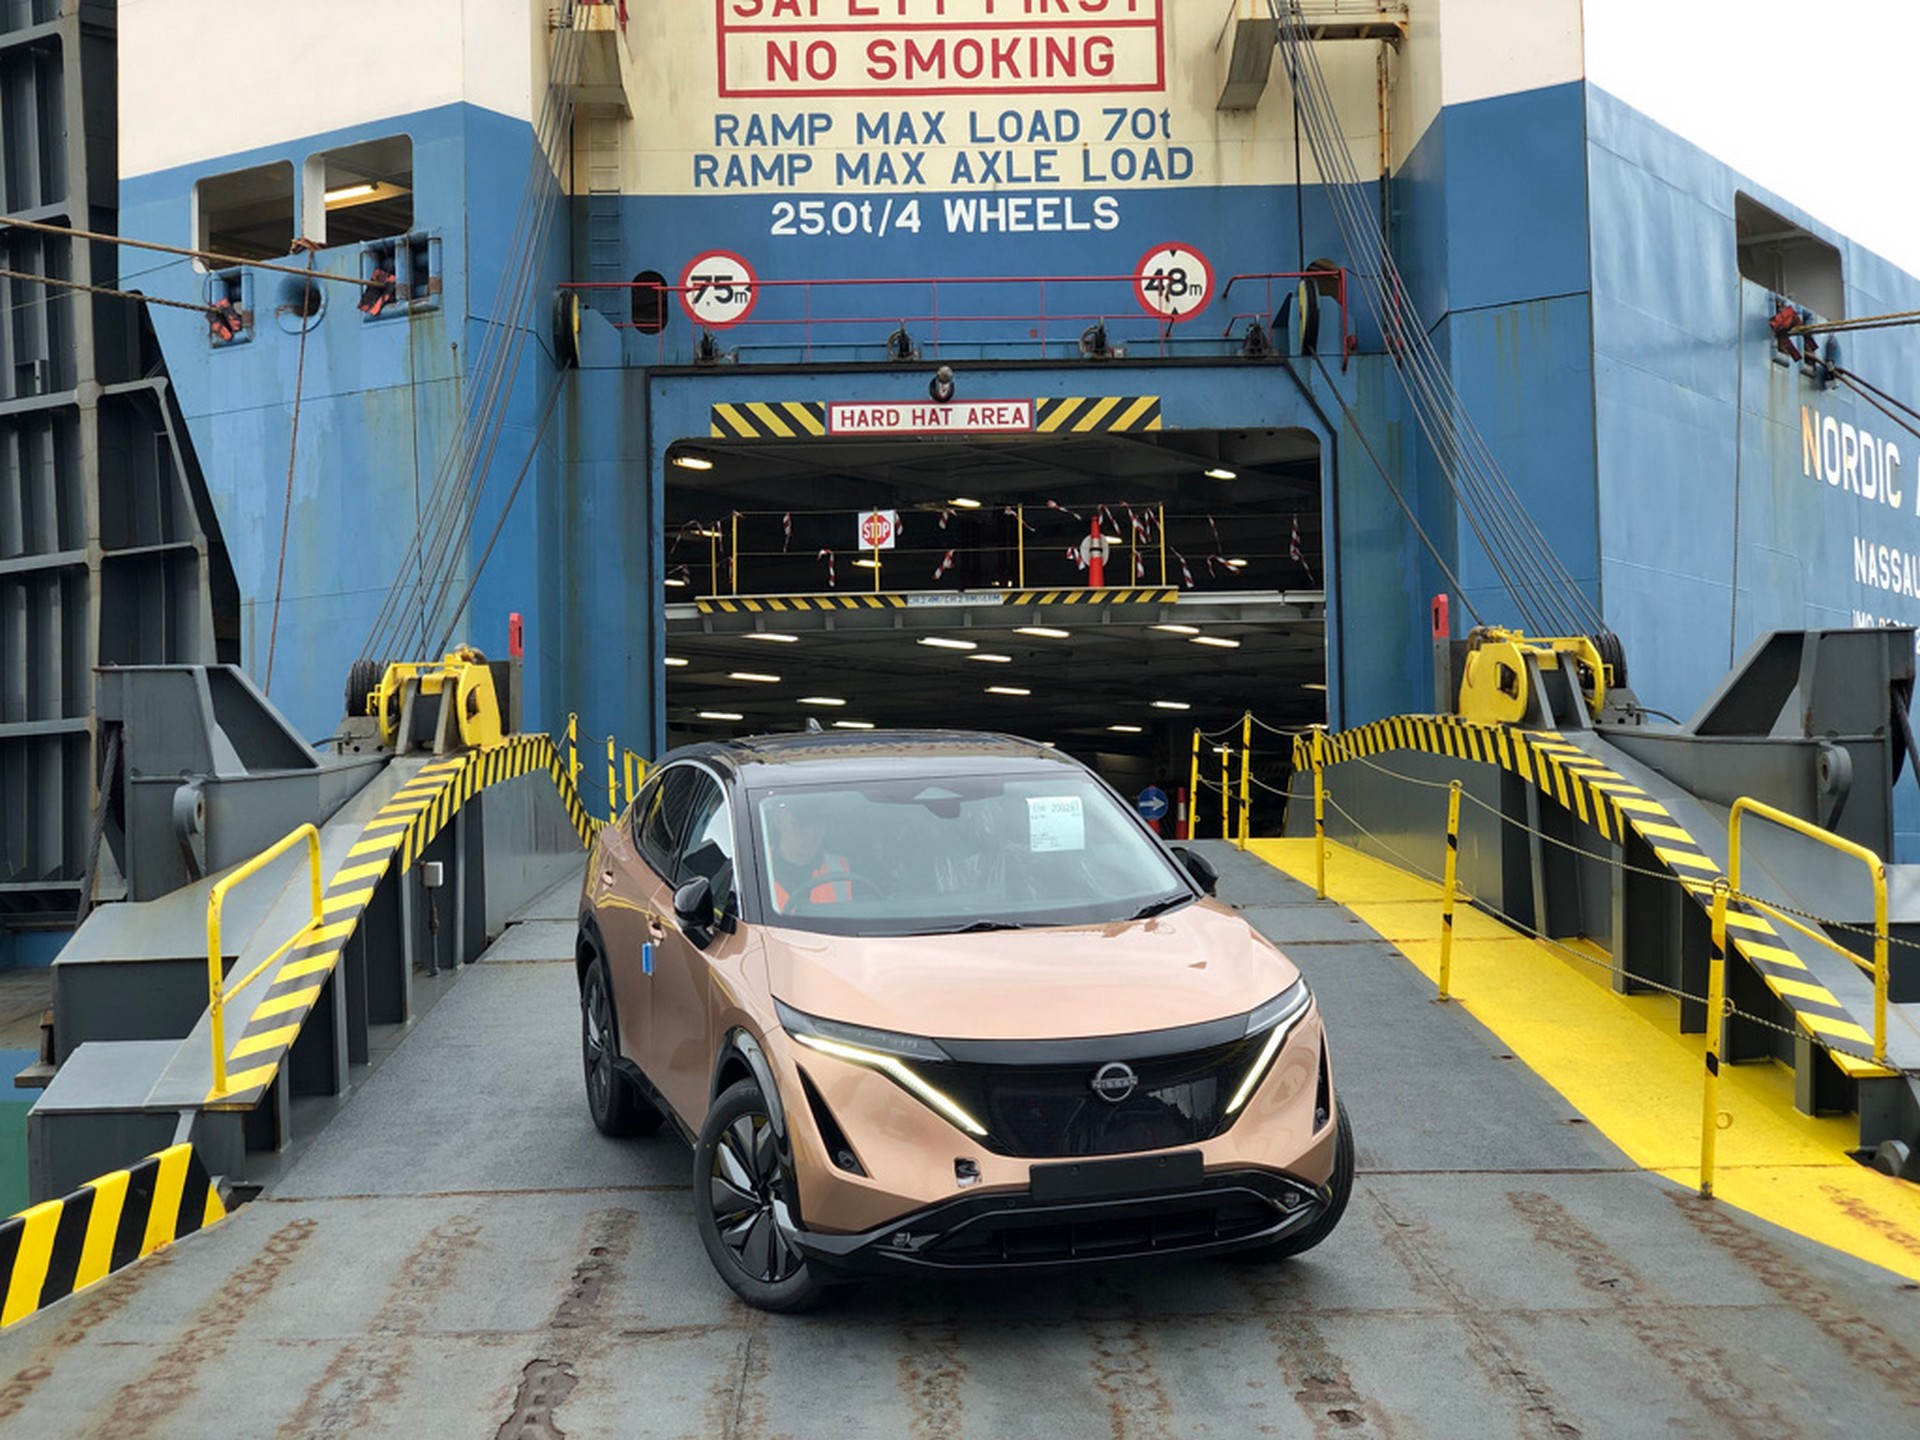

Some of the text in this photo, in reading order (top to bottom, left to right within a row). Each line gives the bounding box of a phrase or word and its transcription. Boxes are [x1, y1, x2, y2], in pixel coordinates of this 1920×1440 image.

[766, 35, 1114, 82] NO SMOKING
[714, 107, 1171, 147] RAMP MAX LOAD 70t
[693, 147, 1193, 188] RAMP MAX AXLE LOAD
[943, 195, 1120, 233] WHEELS
[840, 407, 1025, 427] HARD HAT AREA
[1801, 404, 1902, 510] NORDIC
[863, 521, 890, 539] STOP
[1092, 1076, 1138, 1090] NISSAN
